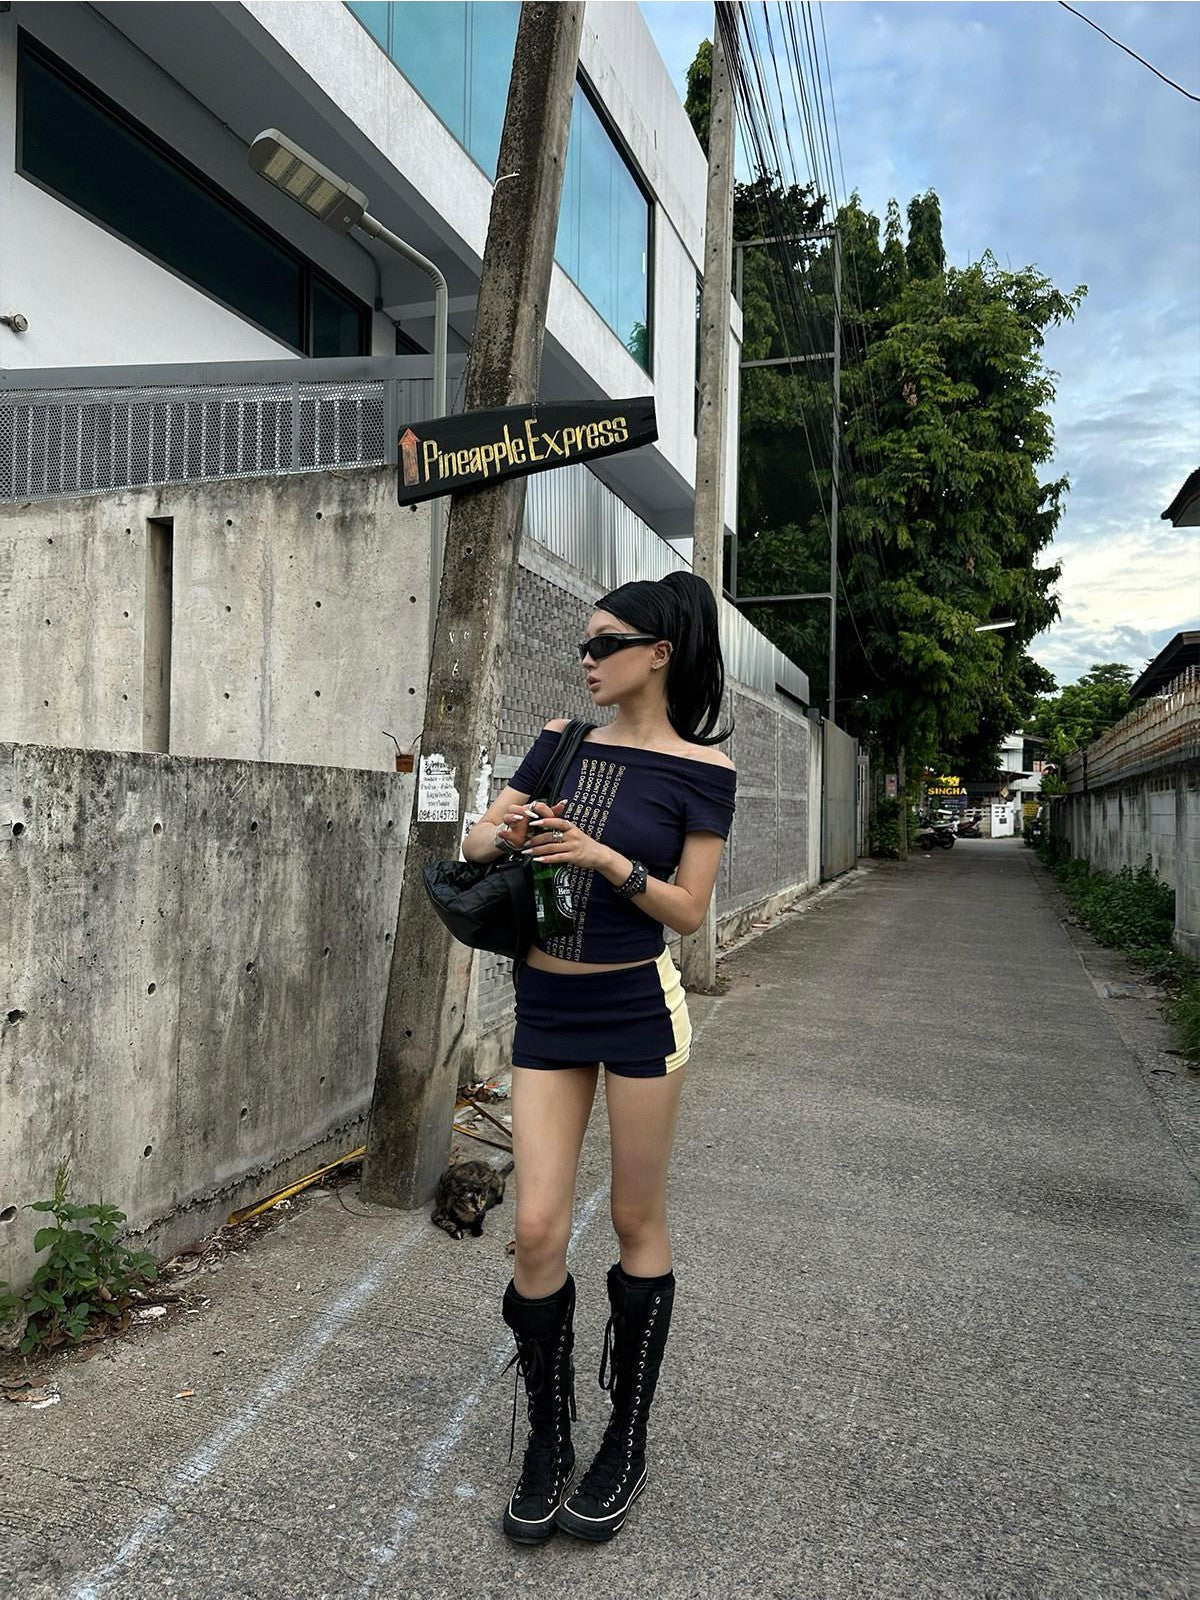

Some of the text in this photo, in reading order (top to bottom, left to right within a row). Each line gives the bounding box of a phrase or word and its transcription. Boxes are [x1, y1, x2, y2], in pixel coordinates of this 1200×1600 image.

[423, 415, 629, 483] Pineapple Express
[581, 759, 589, 775] GIRLS
[589, 760, 598, 776] GIRLS
[597, 761, 607, 778] GIRLS
[606, 763, 616, 780] GIRLS
[615, 766, 626, 781] GIRLS
[927, 787, 967, 795] SINGHA
[564, 802, 576, 819] GIRLS
[573, 804, 583, 820] GIRLS
[581, 806, 591, 822] GIRLS
[590, 808, 600, 825] GIRLS
[598, 810, 609, 827] GIRLS
